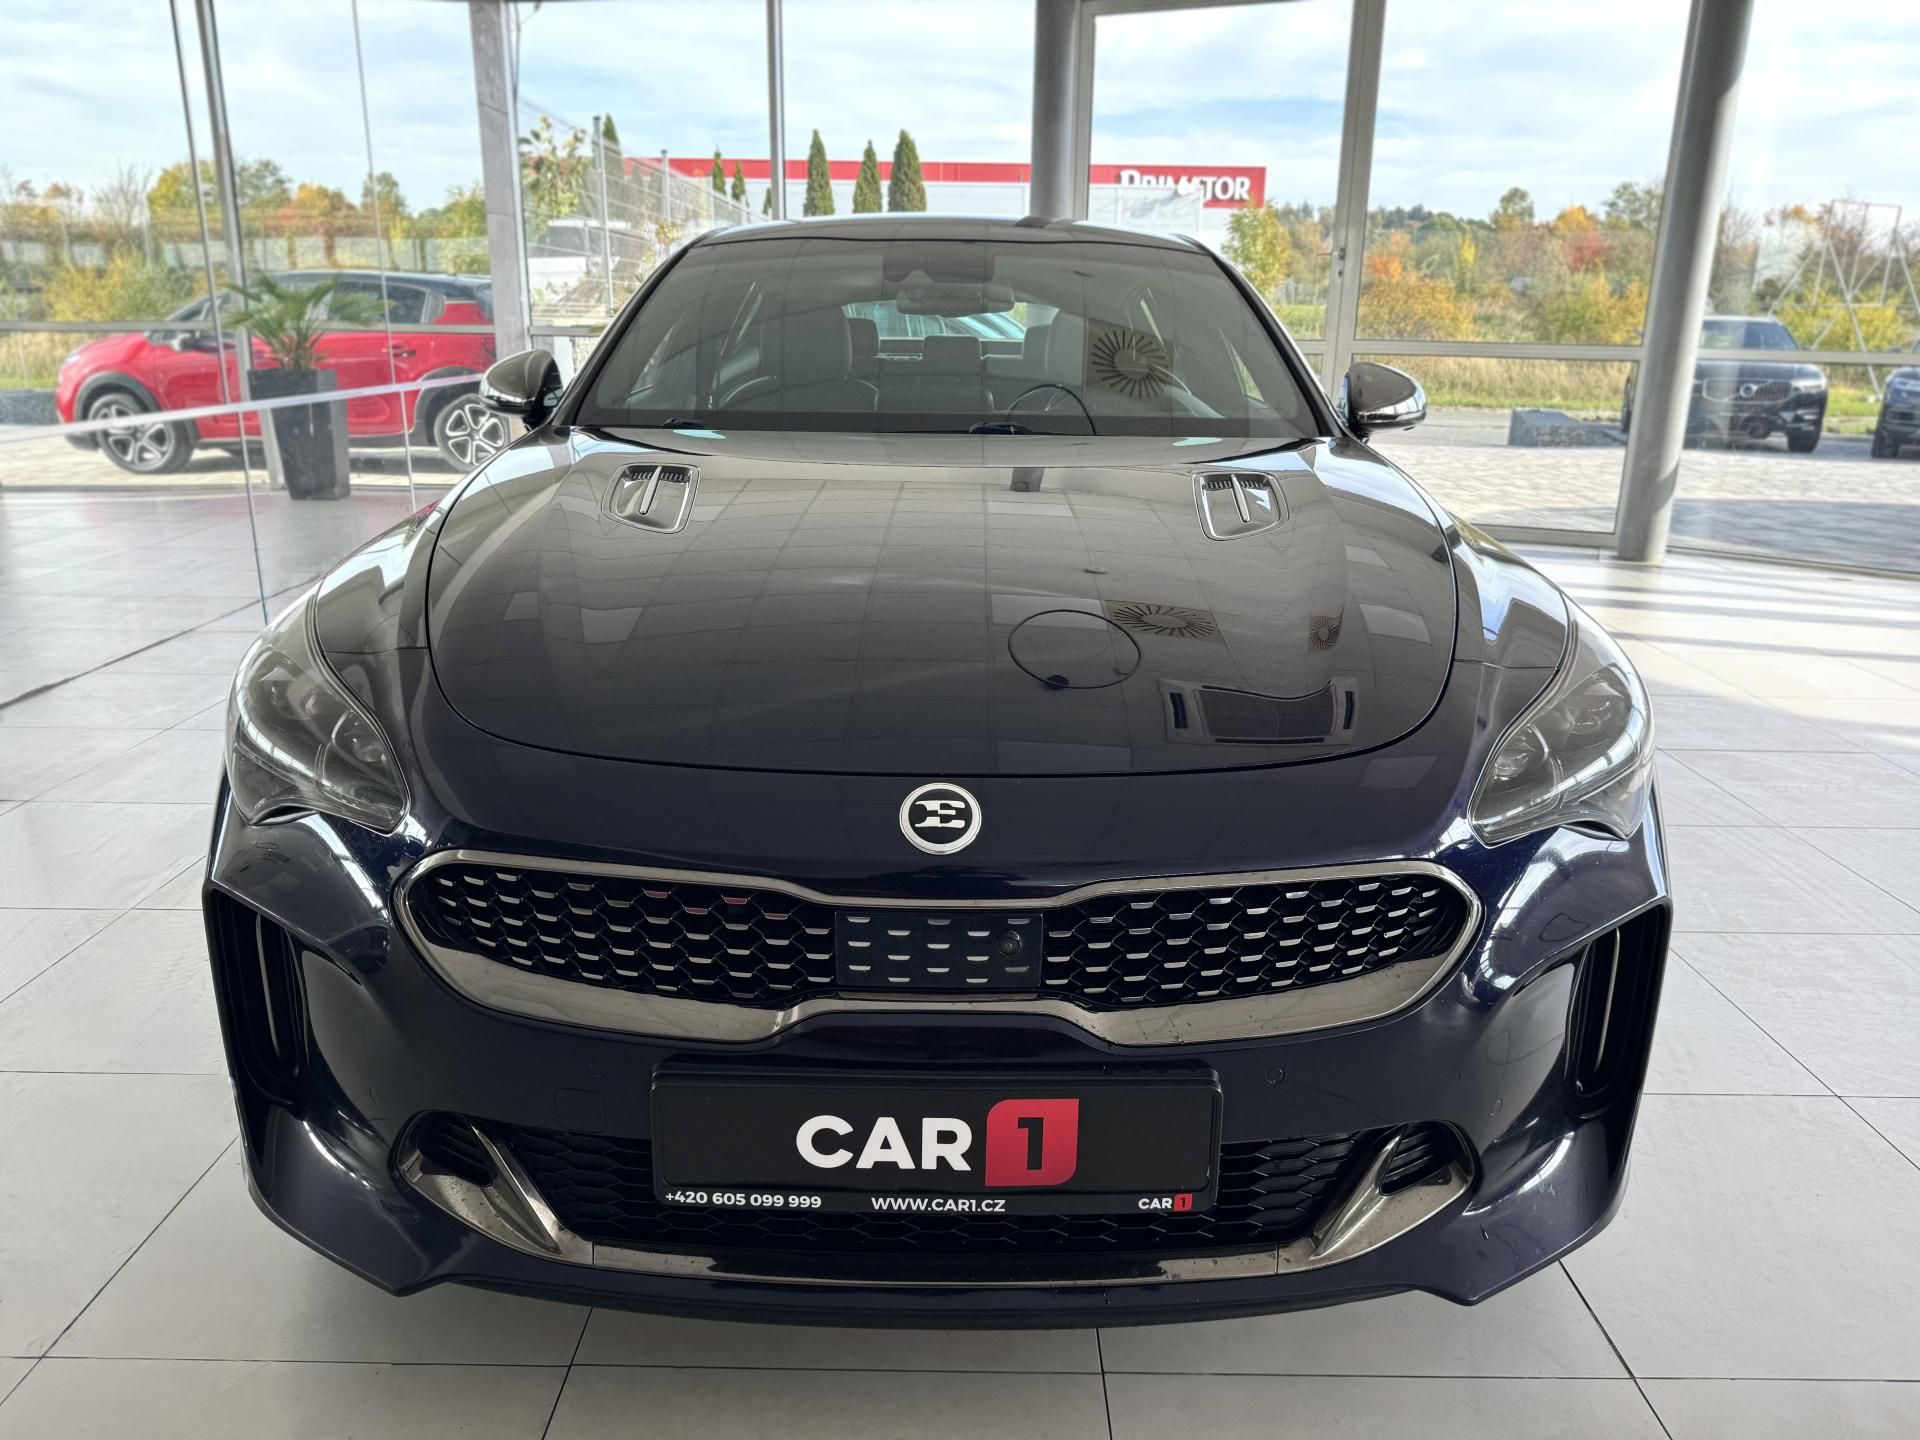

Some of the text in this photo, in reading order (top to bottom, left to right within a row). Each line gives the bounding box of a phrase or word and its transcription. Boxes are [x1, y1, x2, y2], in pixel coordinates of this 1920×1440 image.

[1120, 169, 1251, 201] PTOR
[796, 1114, 973, 1171] CAR
[665, 1191, 822, 1209] +420 605 099 999
[871, 1197, 1006, 1212] WWW.CAR1.CZ
